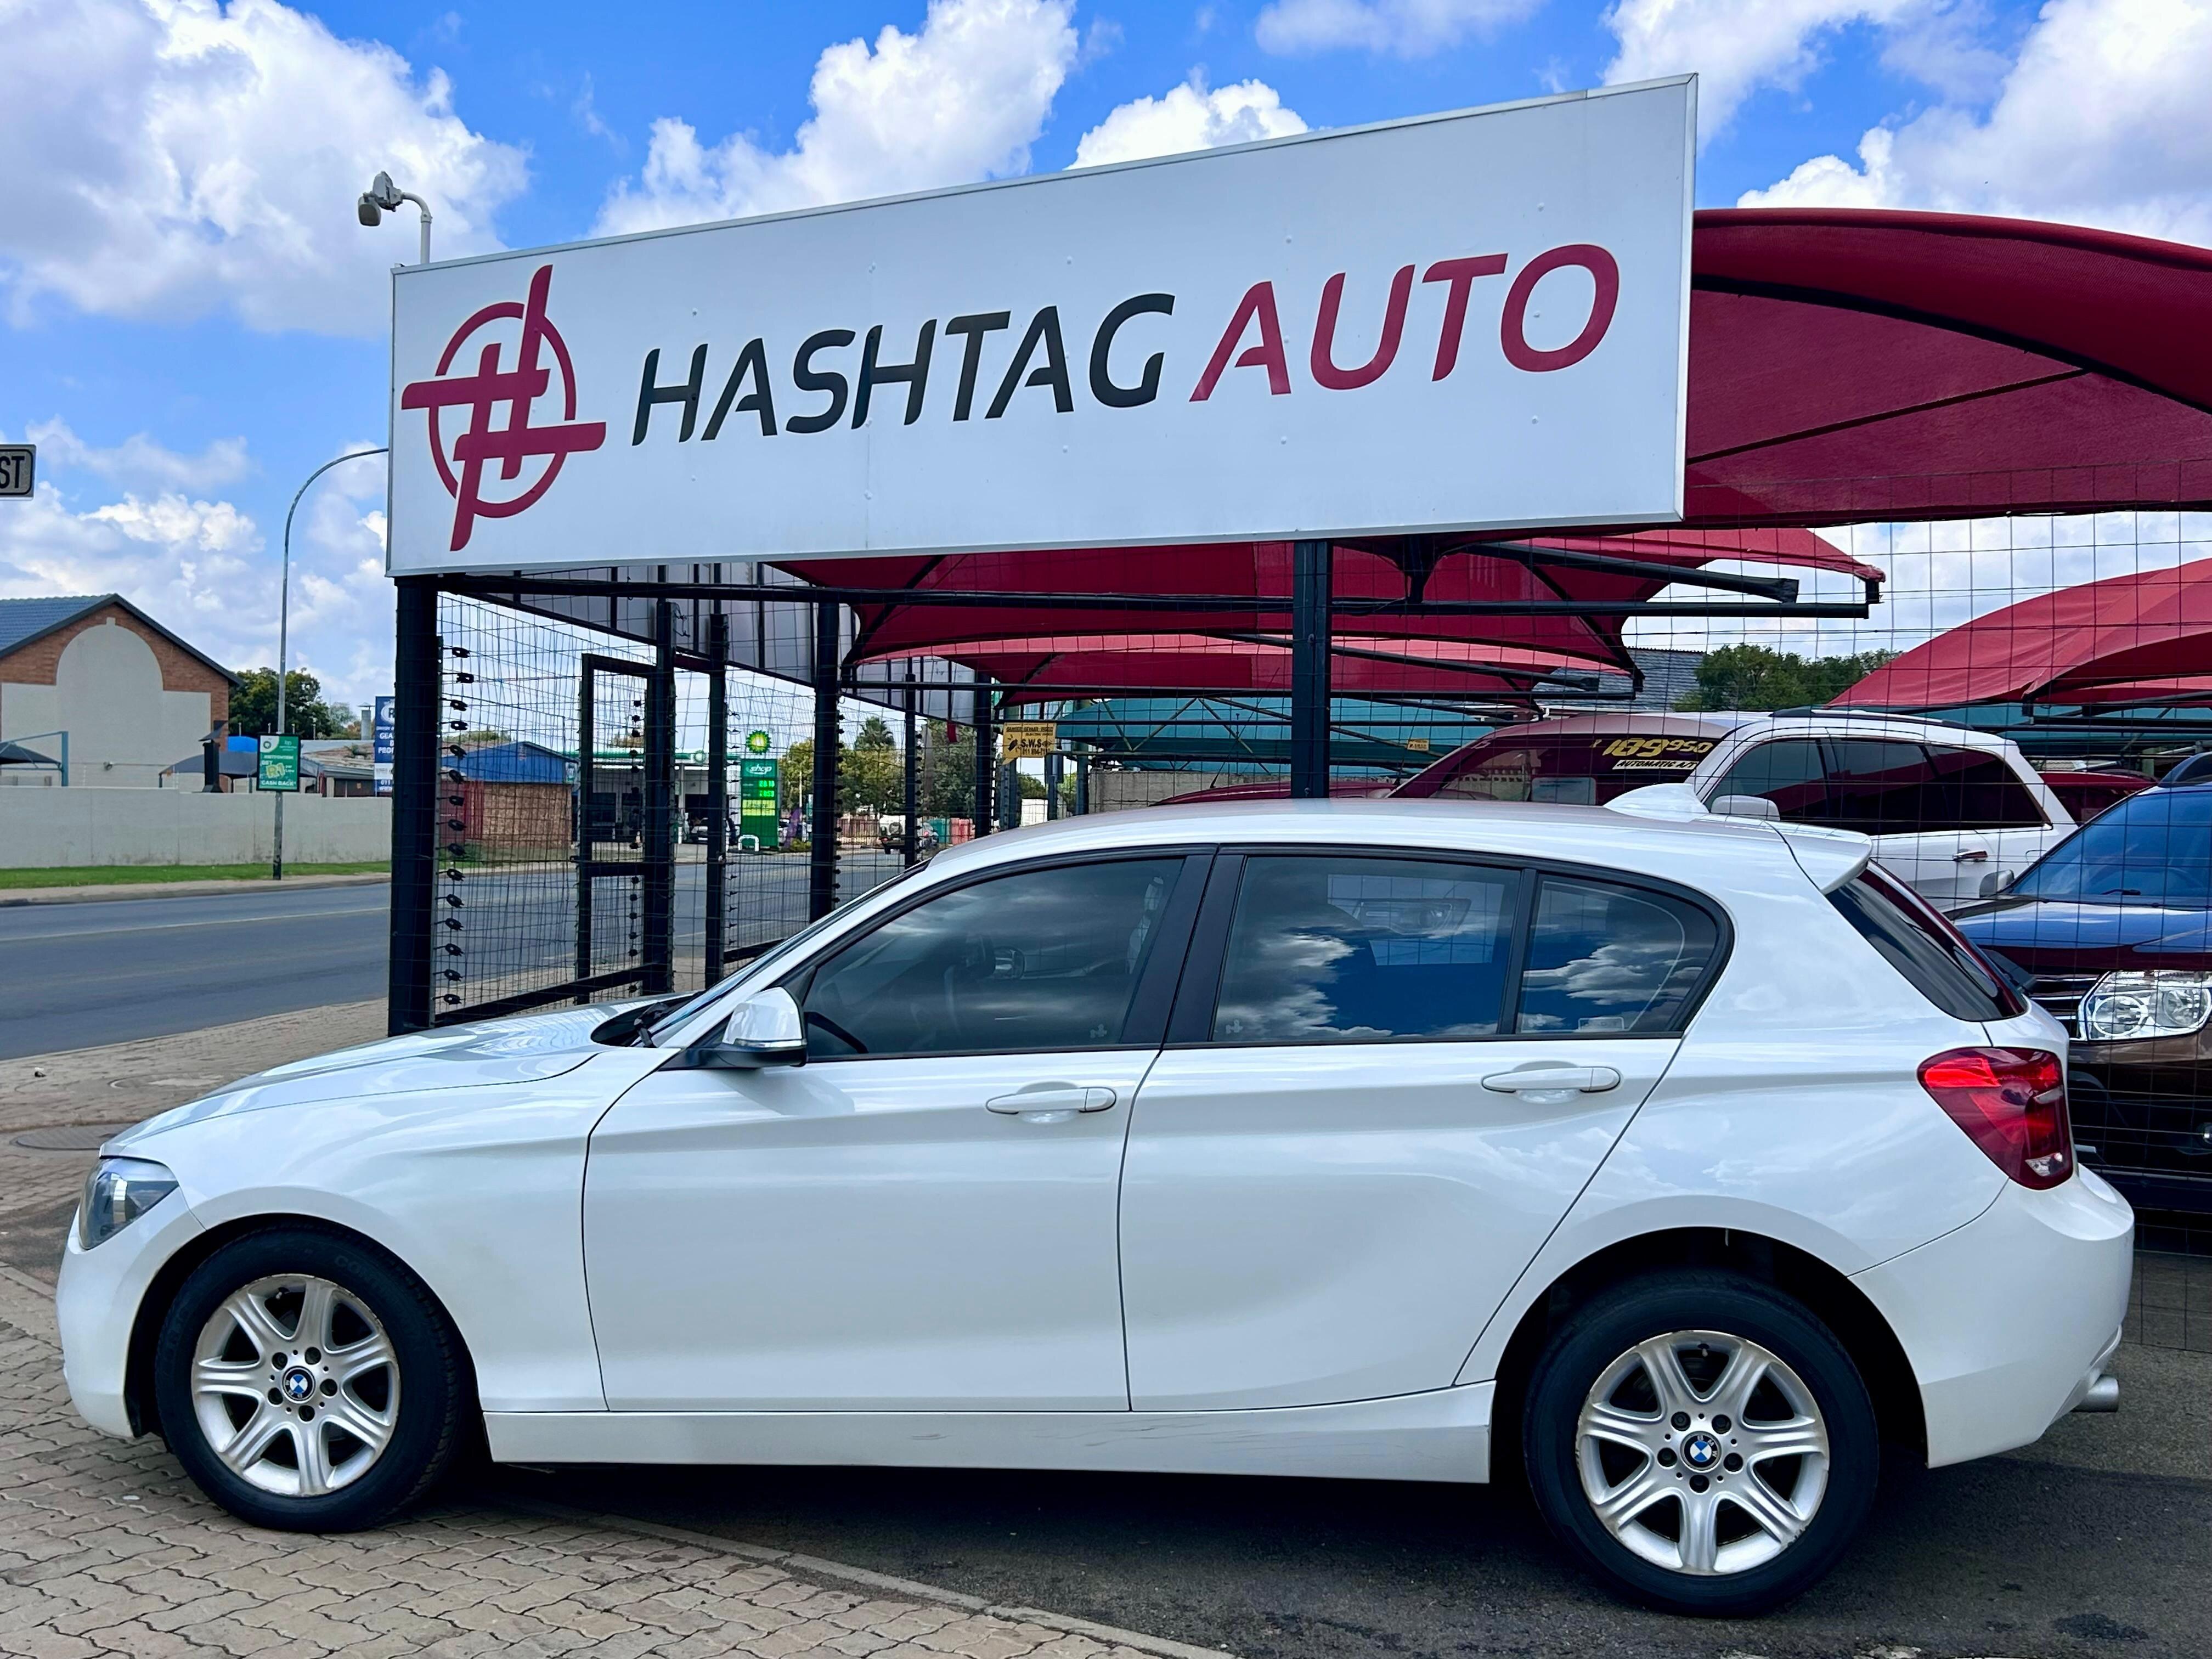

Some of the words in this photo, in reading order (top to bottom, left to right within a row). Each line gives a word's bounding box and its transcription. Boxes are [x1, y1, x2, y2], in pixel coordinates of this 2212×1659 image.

[632, 293, 1175, 445] HASHTAG
[1189, 244, 1620, 402] AUTO
[0, 456, 25, 489] ST
[749, 763, 772, 775] shop
[1616, 760, 1675, 768] AUTOMATIC
